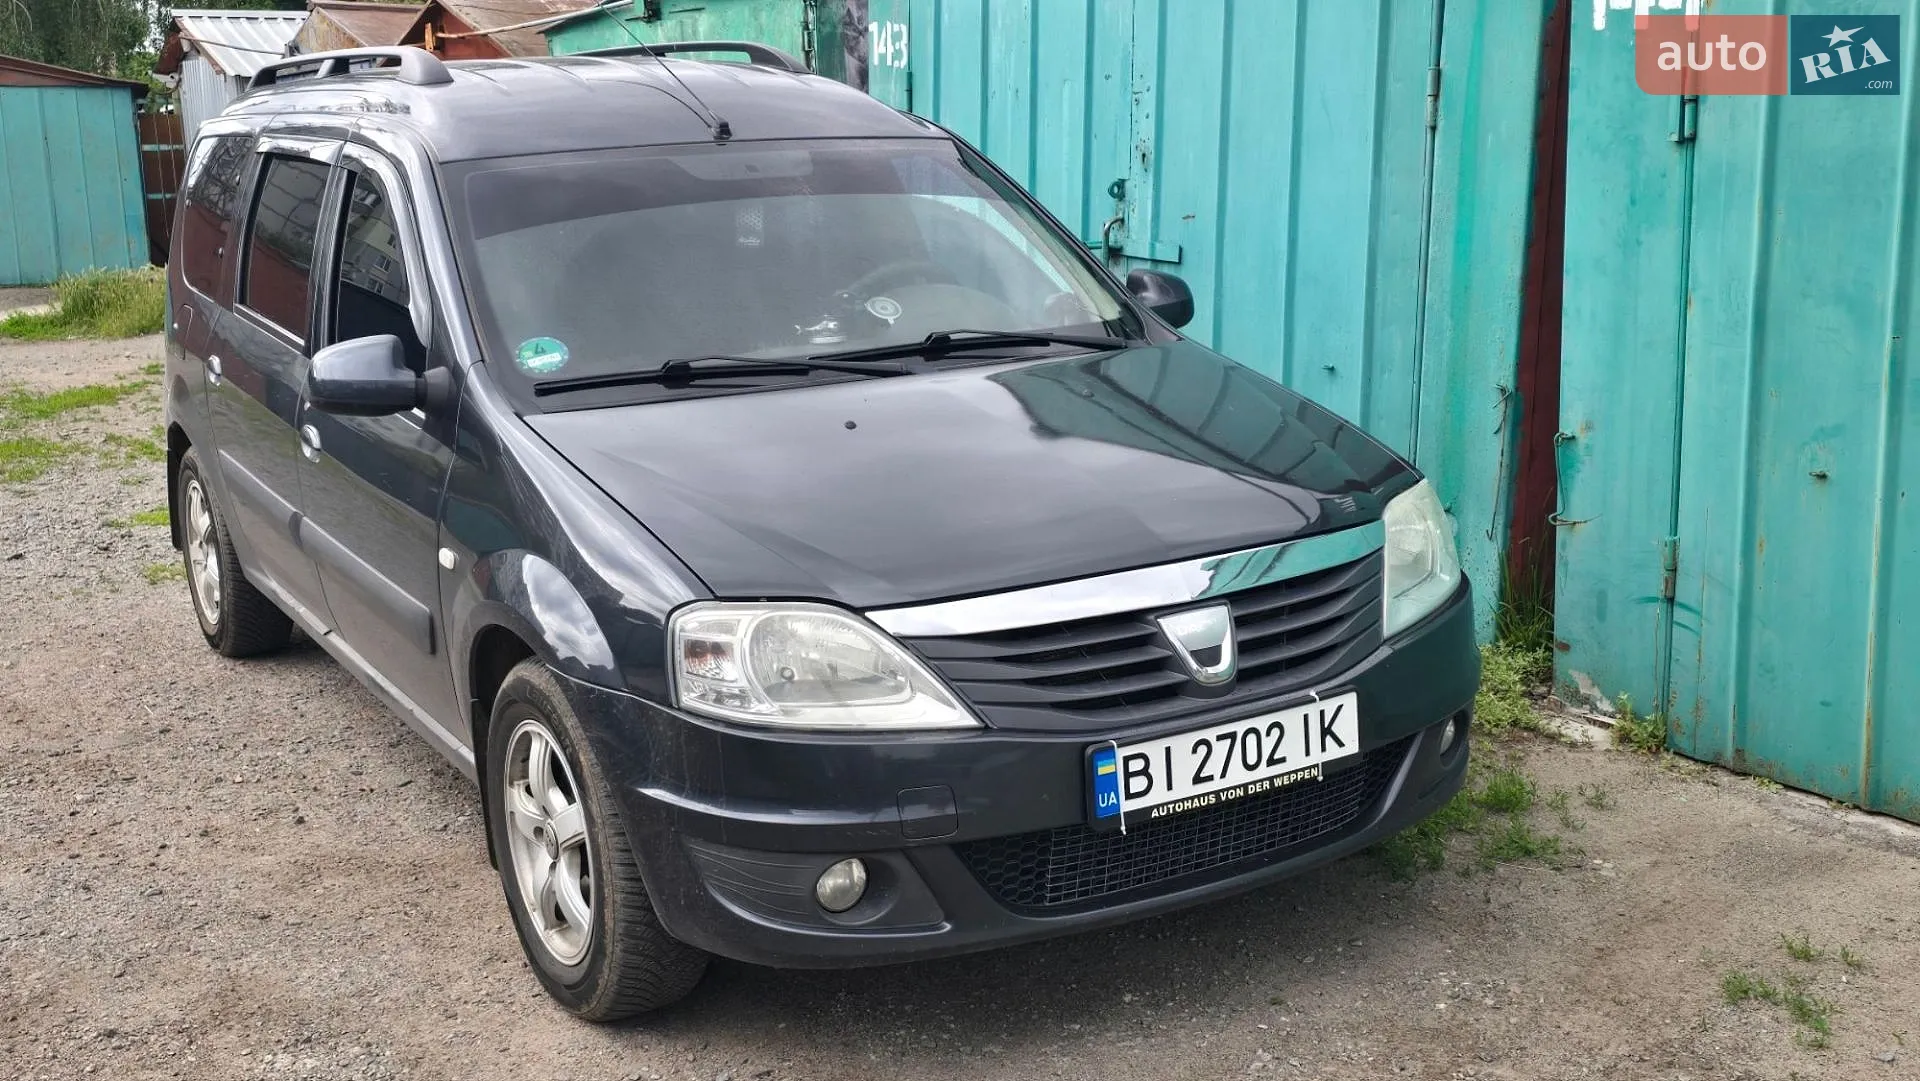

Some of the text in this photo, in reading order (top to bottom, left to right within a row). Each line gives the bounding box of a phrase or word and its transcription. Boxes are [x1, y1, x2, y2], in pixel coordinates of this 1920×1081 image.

[868, 20, 908, 69] 143
[1122, 703, 1346, 802] BI 2702 IK
[1099, 793, 1118, 809] UA
[1151, 767, 1319, 819] AUTOHAUS VON DER WEPPEN
